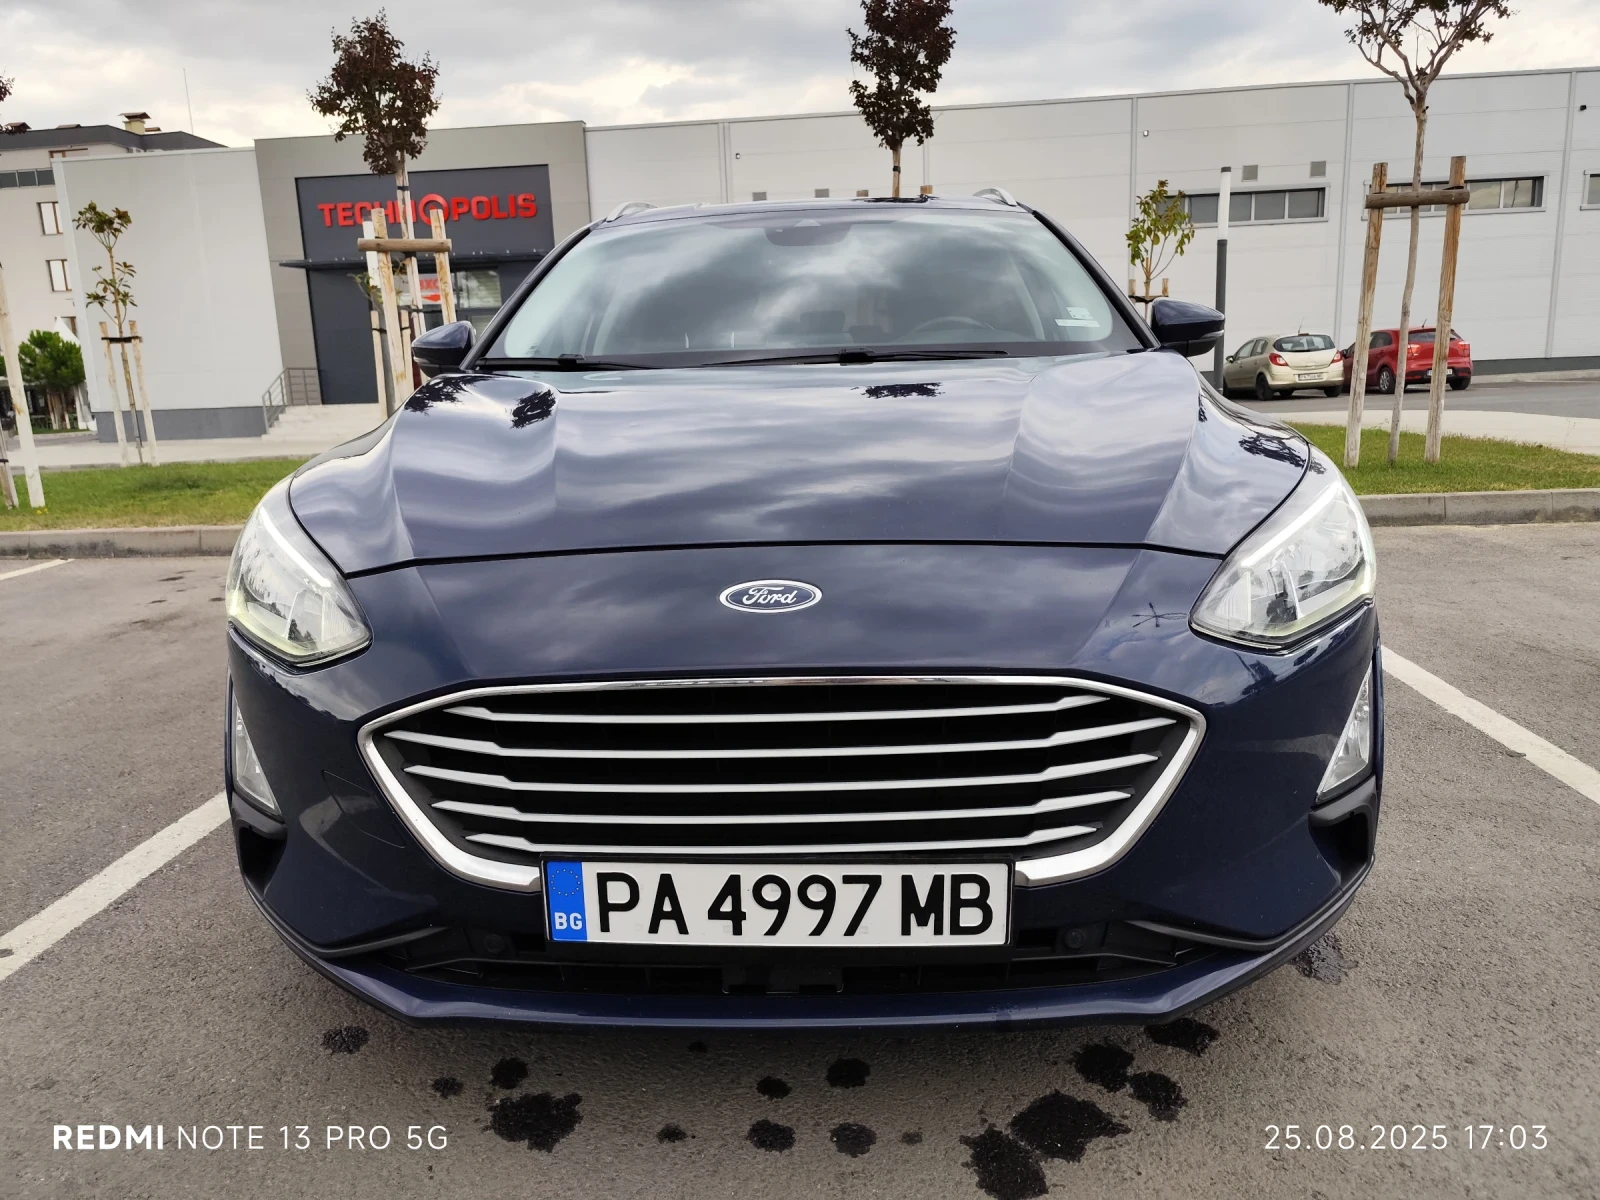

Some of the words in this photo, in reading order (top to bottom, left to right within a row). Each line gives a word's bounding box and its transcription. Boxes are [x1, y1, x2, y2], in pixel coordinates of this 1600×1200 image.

[742, 586, 798, 605] Ford
[597, 872, 689, 935] PA
[708, 874, 882, 937] 4997
[901, 874, 993, 936] MB
[555, 912, 583, 931] BG
